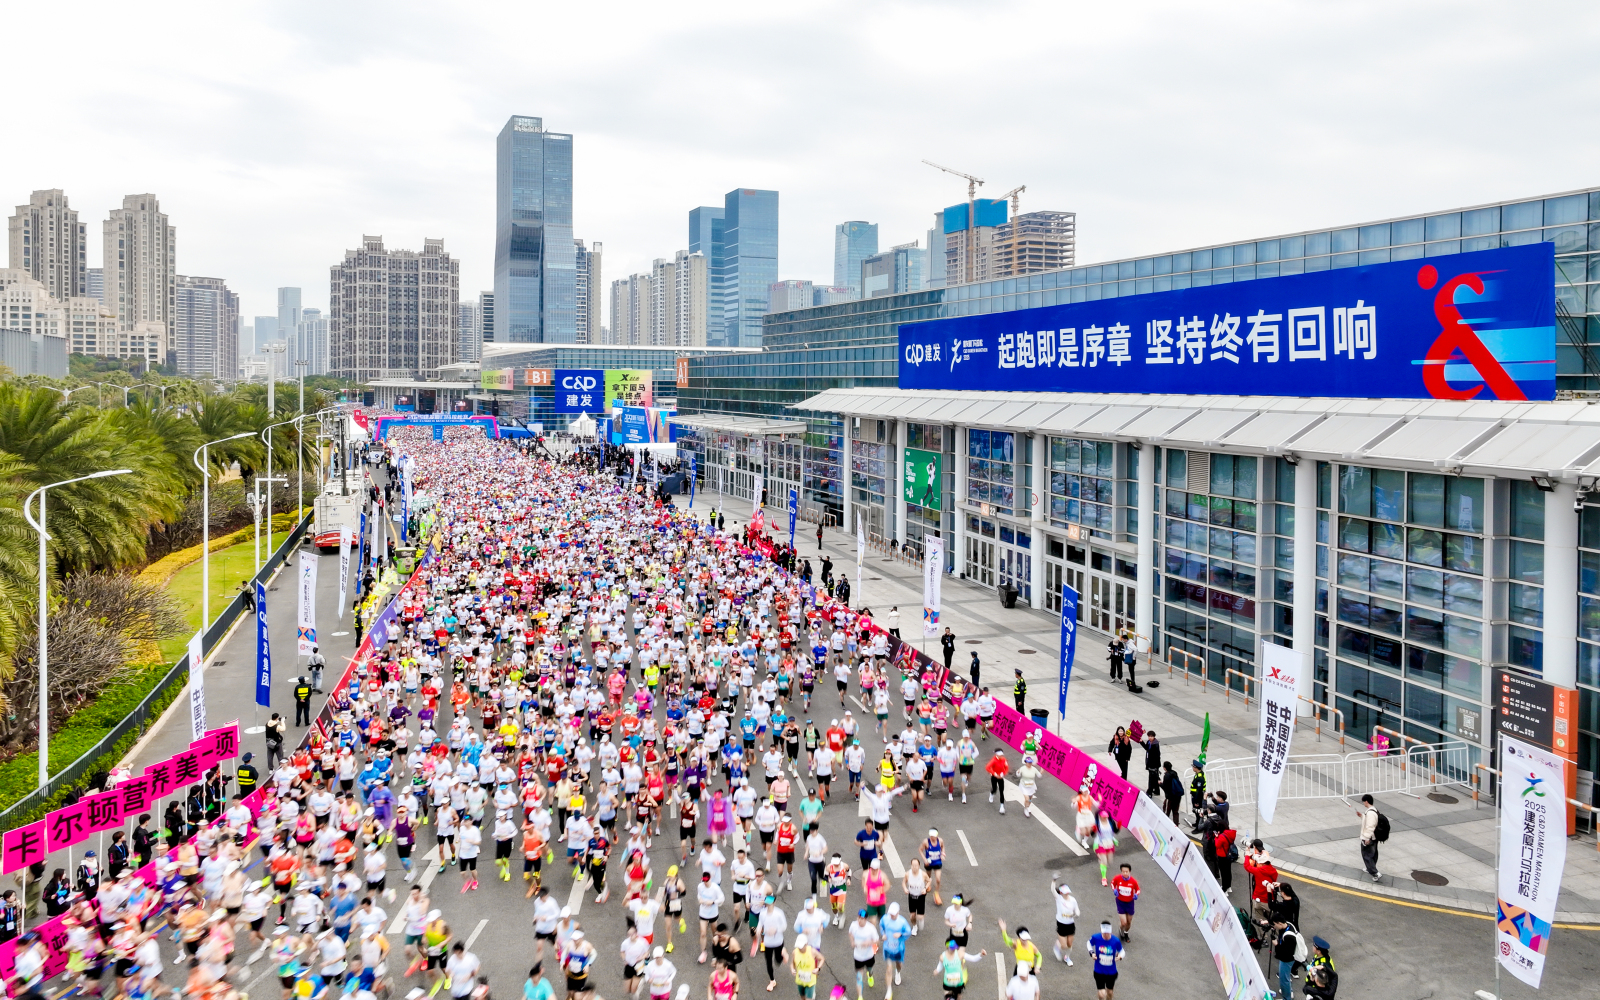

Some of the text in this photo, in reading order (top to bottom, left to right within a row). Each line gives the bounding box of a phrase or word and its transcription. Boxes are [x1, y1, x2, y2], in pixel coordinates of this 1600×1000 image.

[997, 298, 1378, 370] 起跑即是序章 坚持终有回响
[905, 343, 941, 367] C&D 建发
[532, 371, 546, 383] B1
[562, 376, 596, 391] C&D
[677, 361, 688, 384] A1
[566, 394, 592, 407] 建发
[982, 506, 995, 516] A2 22
[1069, 527, 1088, 540] A2 21
[995, 712, 1016, 736] 卡尔顿
[1260, 699, 1278, 771] 世界跑鞋
[1272, 706, 1292, 775] 中国特步
[1041, 741, 1066, 768] 卡尔顿
[1095, 778, 1124, 808] 卡尔顿
[1524, 799, 1546, 814] 2025
[1518, 810, 1535, 898] 建发厦门马拉松
[1536, 830, 1545, 860] XIAMEN
[1531, 860, 1542, 902] MARATHON
